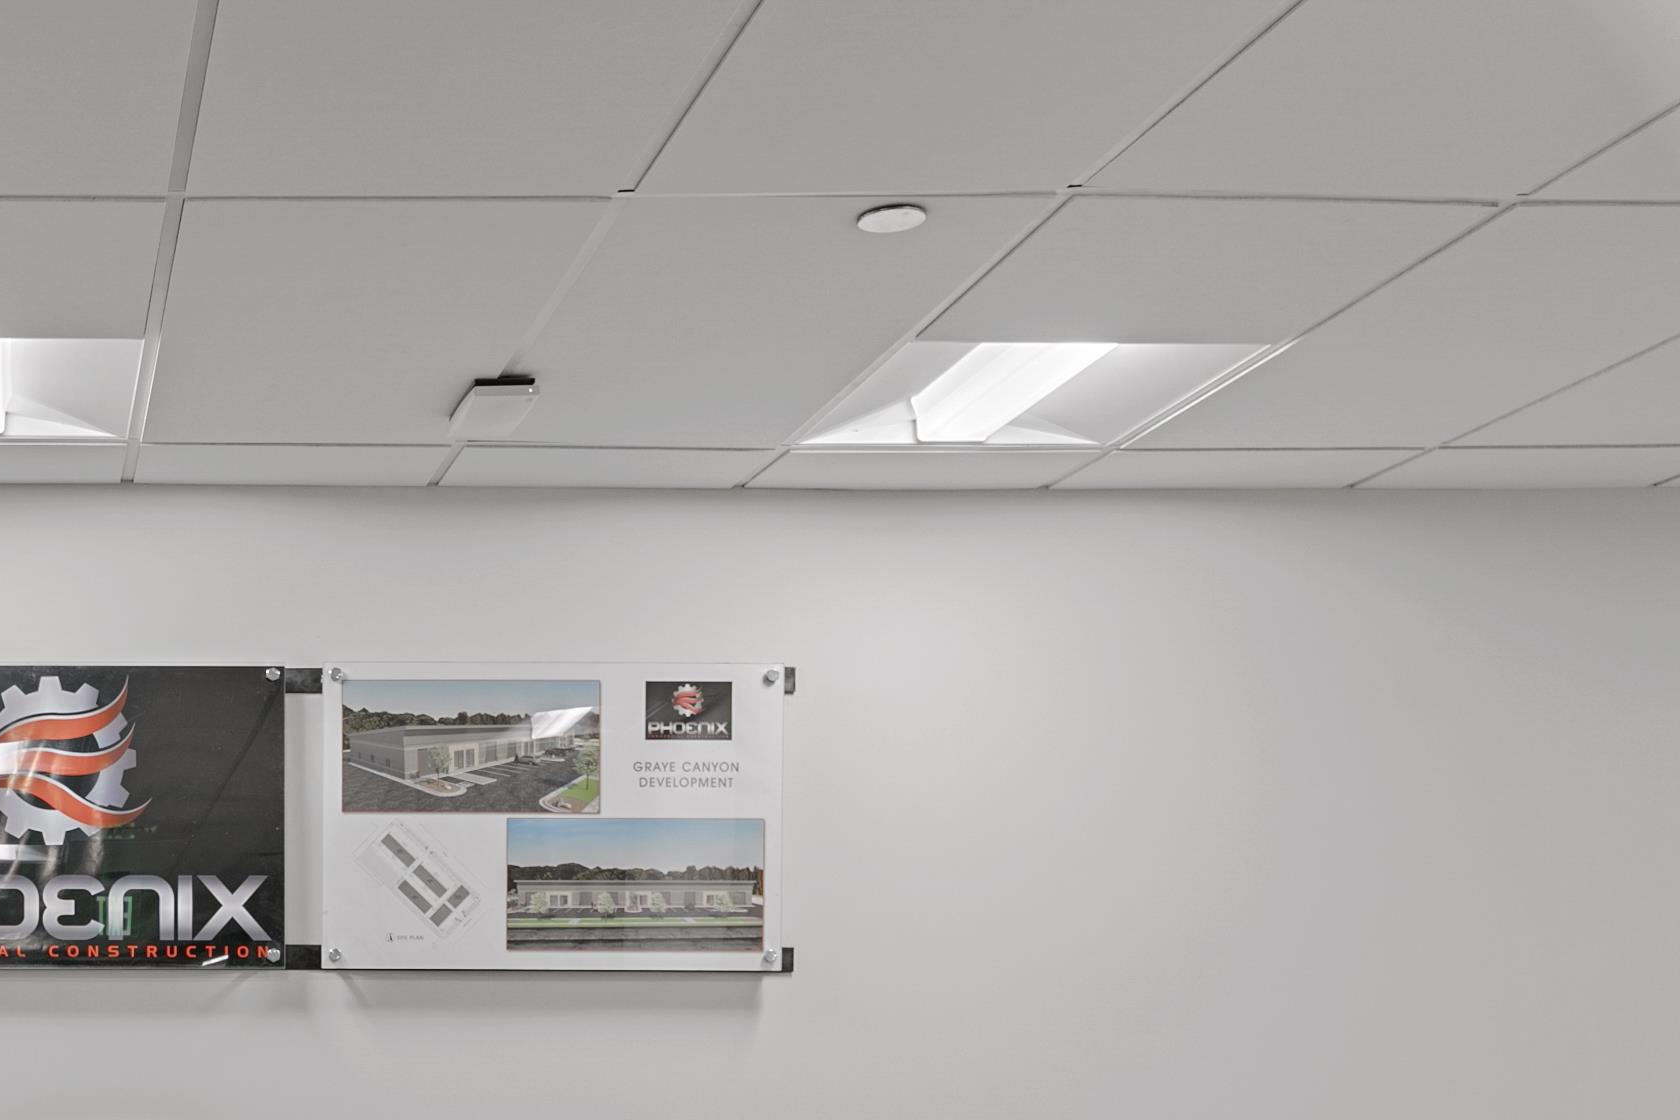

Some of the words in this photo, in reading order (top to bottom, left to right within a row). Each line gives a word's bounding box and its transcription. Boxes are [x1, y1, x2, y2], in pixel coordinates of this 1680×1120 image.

[648, 722, 729, 734] PHOENIX
[633, 761, 676, 772] GRAYE
[682, 761, 740, 772] CANYON
[639, 777, 734, 788] DEVELOPMENT
[47, 945, 269, 958] CONSTRUCTION
